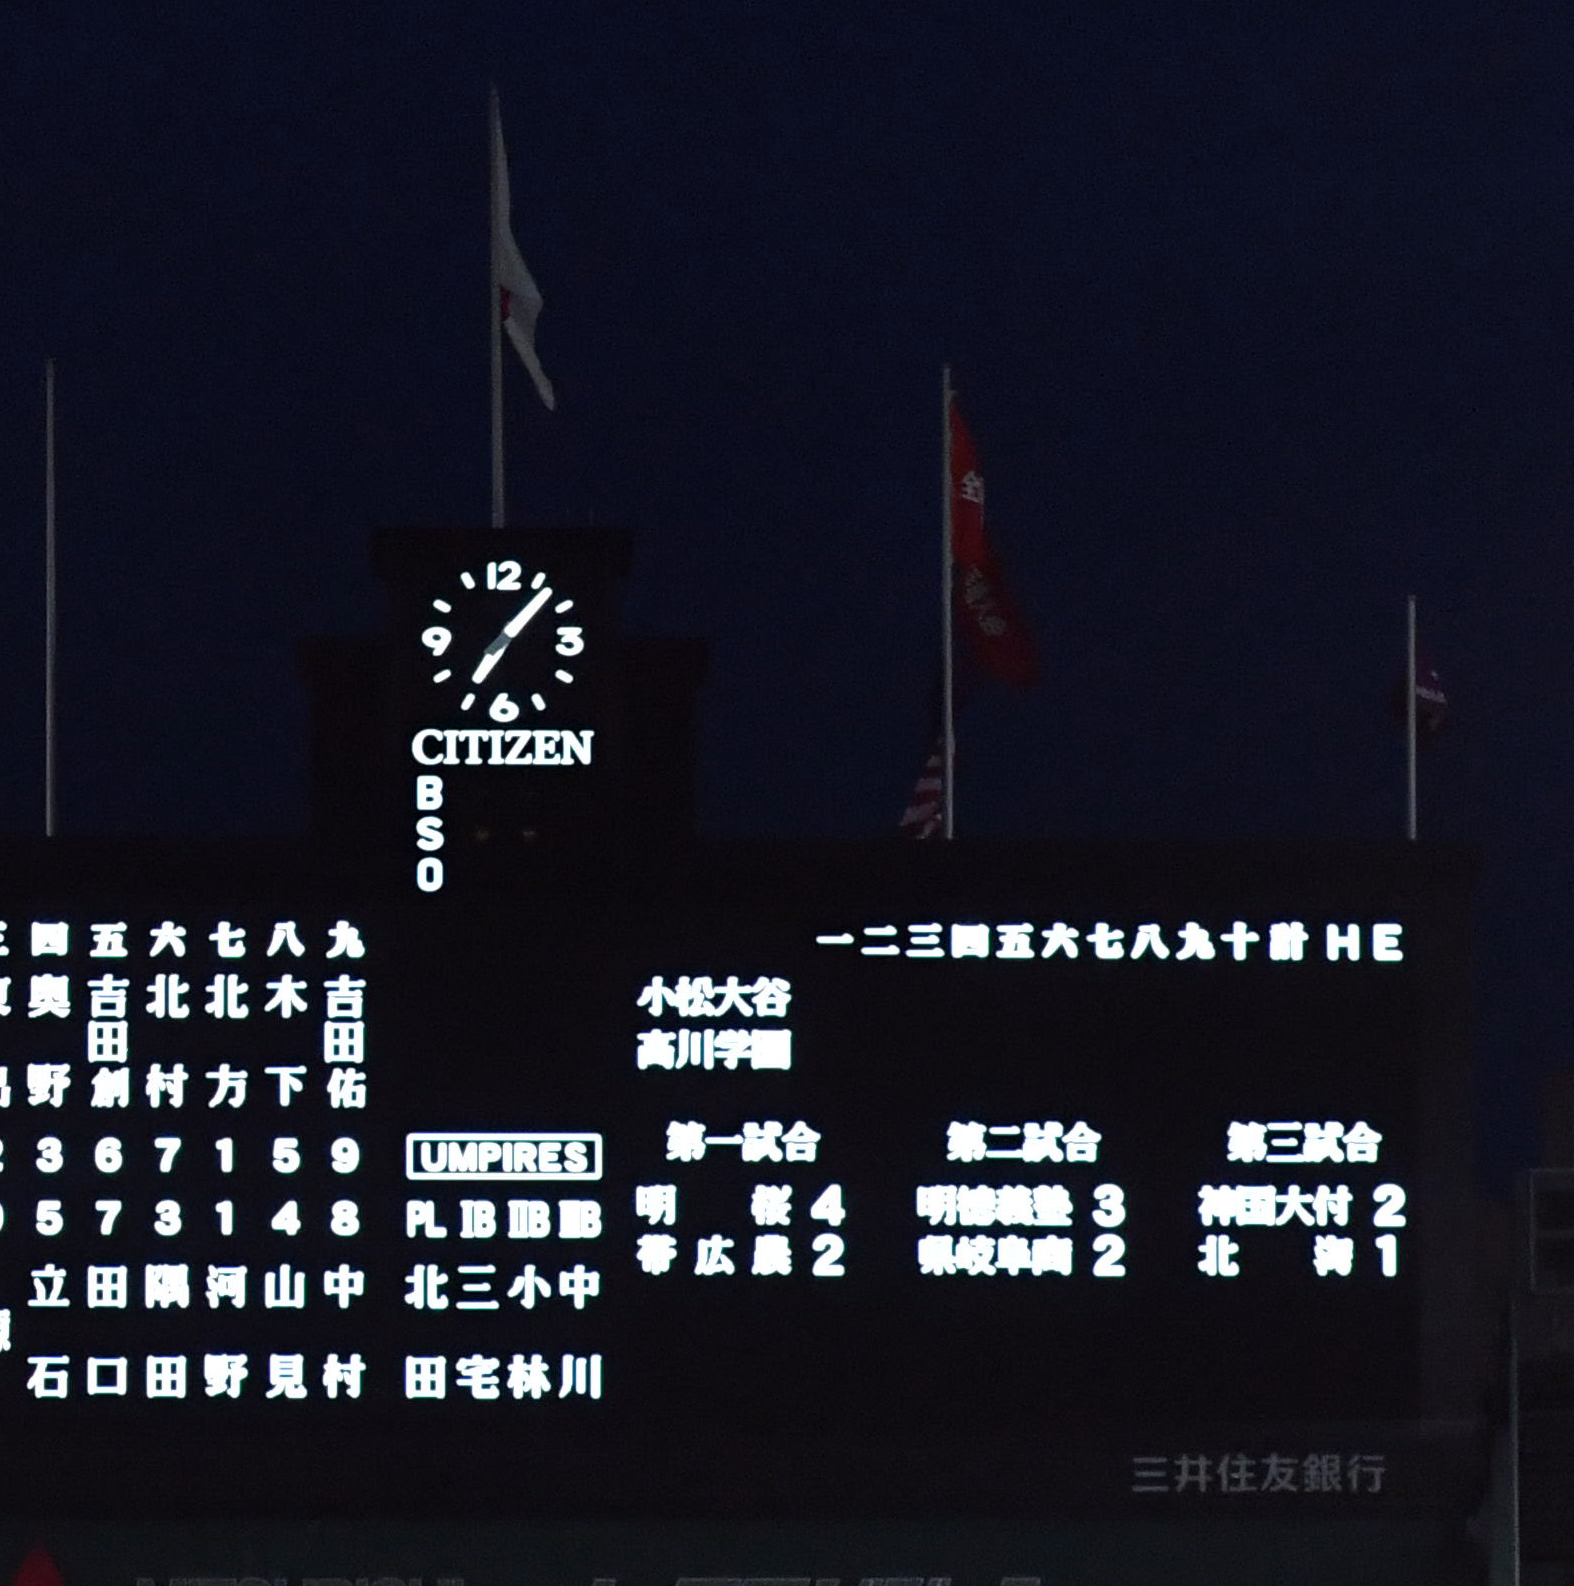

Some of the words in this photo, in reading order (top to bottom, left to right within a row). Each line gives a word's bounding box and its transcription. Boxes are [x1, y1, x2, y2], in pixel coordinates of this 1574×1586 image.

[487, 561, 521, 590] 12
[422, 627, 452, 656] 9
[556, 627, 584, 656] 3
[489, 693, 519, 722] 6
[412, 729, 594, 765] CITIZEN
[417, 775, 443, 810] B
[416, 816, 444, 851] S
[417, 857, 443, 892] O
[31, 922, 69, 956] 四
[90, 922, 128, 957] 五
[150, 921, 186, 957] 六
[209, 921, 246, 958] 七
[267, 921, 305, 957] 八
[326, 920, 365, 958] 九
[637, 976, 791, 1017] 小松大谷
[146, 974, 189, 1108] 北村
[205, 974, 249, 1108] 北方
[264, 974, 307, 1106] 木下
[637, 1028, 792, 1070] 高川学園
[36, 1136, 63, 1173] 3
[95, 1137, 122, 1173] 6
[154, 1137, 181, 1172] 7
[216, 1138, 233, 1172] 1
[272, 1137, 300, 1173] 5
[331, 1137, 359, 1173] 9
[420, 1141, 588, 1173] UMPIRES
[666, 1120, 821, 1162] 第一試合
[946, 1121, 1102, 1162] 第二試合
[1227, 1121, 1382, 1163] 第三試合
[36, 1200, 63, 1236] 5
[95, 1200, 122, 1235] 7
[154, 1200, 182, 1236] 3
[215, 1200, 233, 1235] 1
[271, 1200, 301, 1235] 4
[330, 1200, 359, 1236] 8
[406, 1200, 447, 1238] PL
[810, 1184, 845, 1226] 4
[1092, 1184, 1126, 1228] 3
[1373, 1183, 1406, 1227] 2
[812, 1233, 845, 1276] 2
[1092, 1233, 1125, 1277] 2
[1375, 1234, 1397, 1277] 1
[27, 1264, 70, 1398] 立石
[87, 1265, 127, 1395] 田口
[265, 1264, 307, 1398] 山見
[323, 1264, 366, 1398] 中村
[1132, 1452, 1387, 1493] 三井住友銀行
